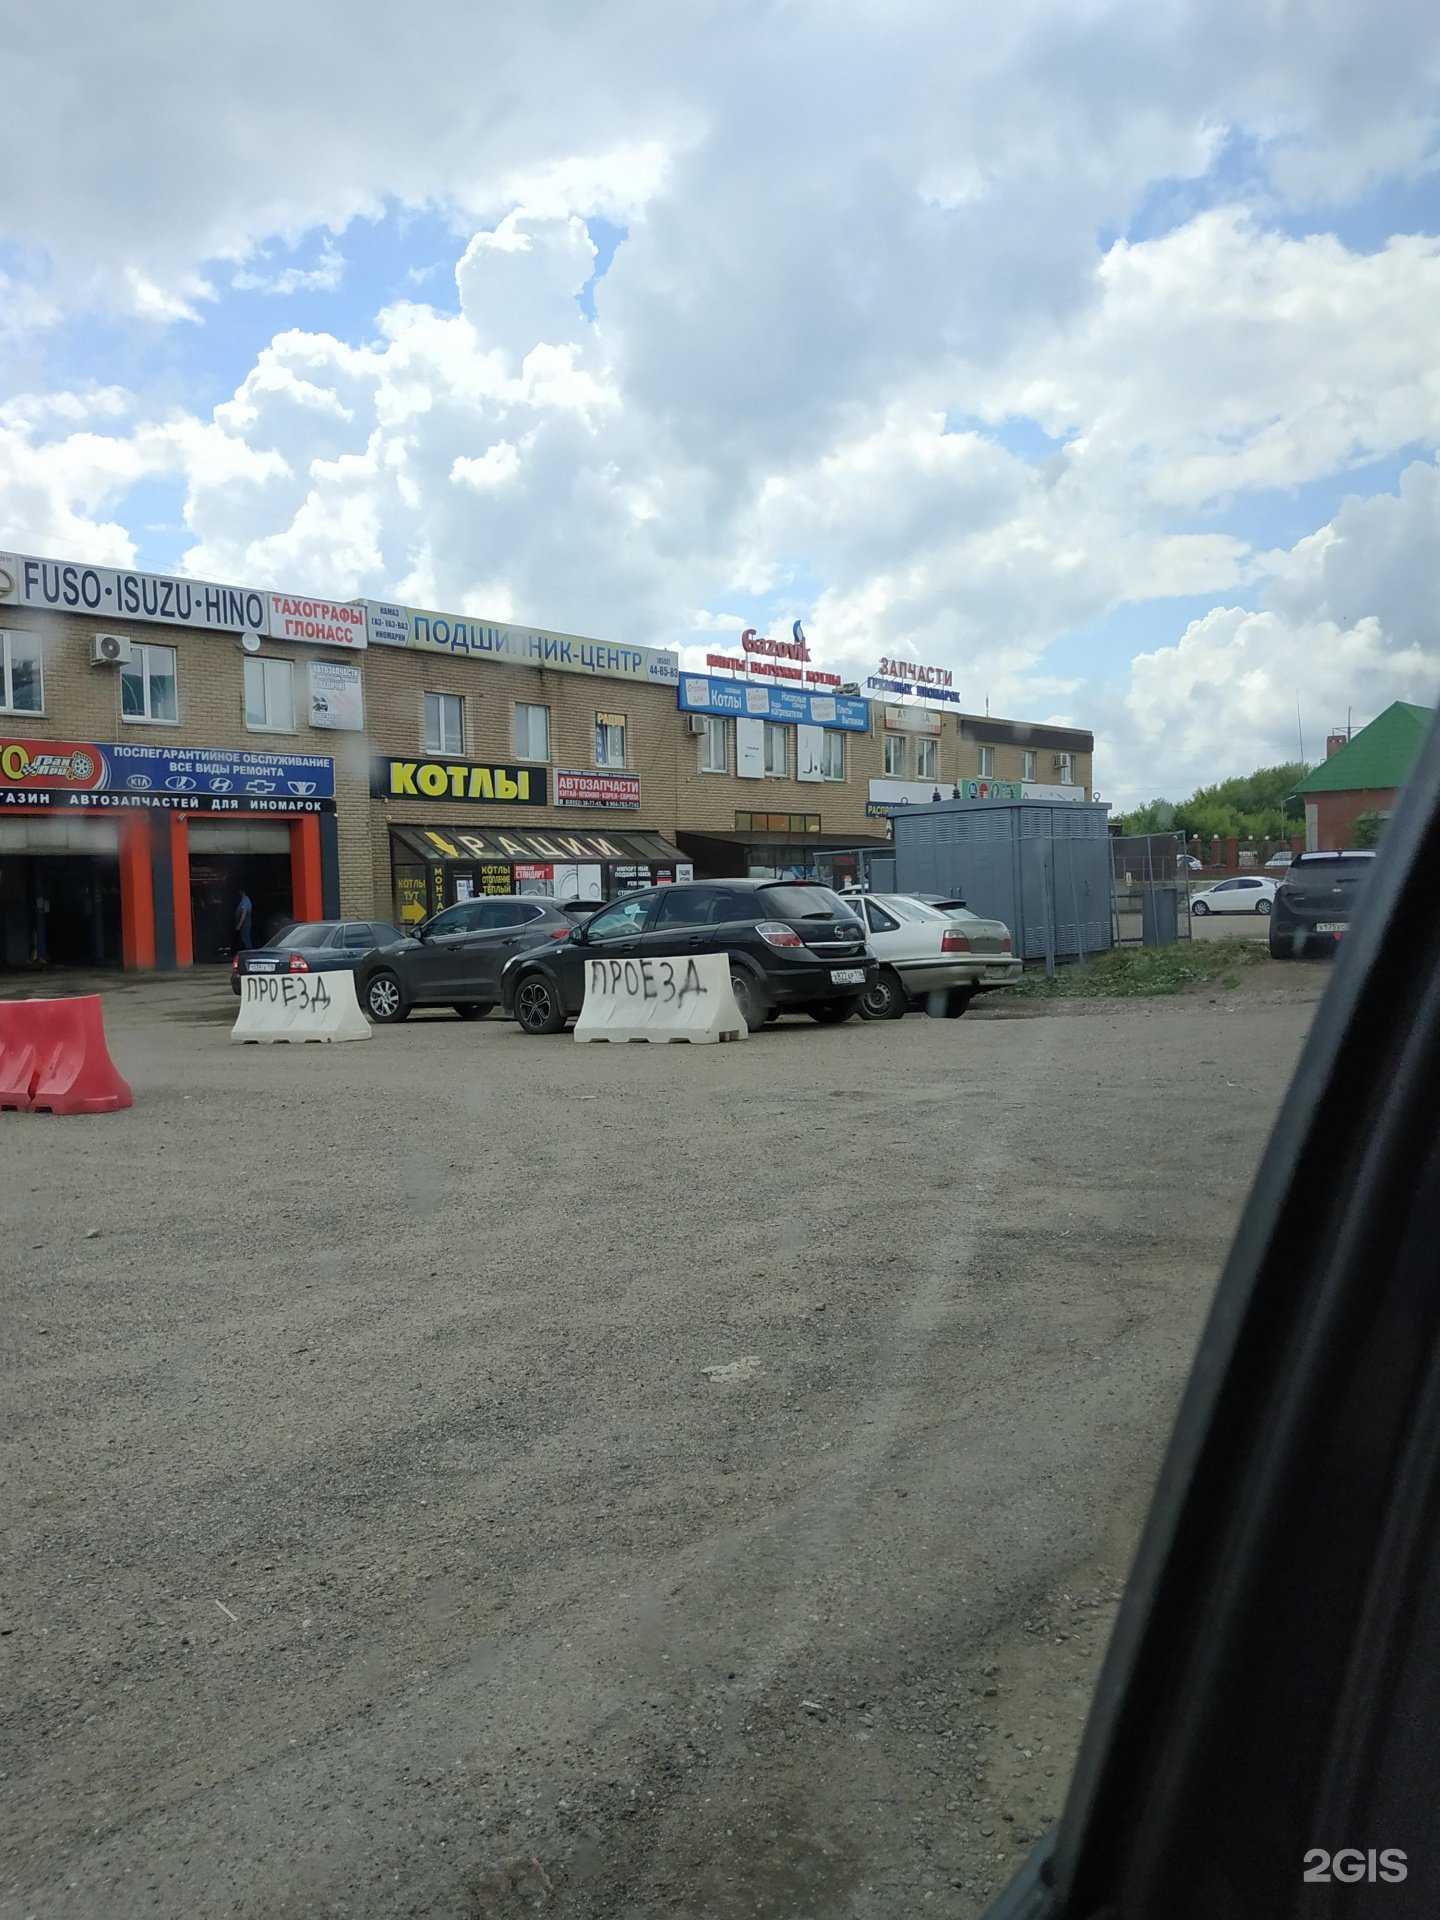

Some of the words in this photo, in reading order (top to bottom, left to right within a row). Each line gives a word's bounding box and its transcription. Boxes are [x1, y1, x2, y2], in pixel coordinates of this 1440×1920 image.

[24, 561, 101, 608] FUSO
[116, 574, 192, 619] ISUZU
[205, 589, 263, 628] HINO
[272, 594, 363, 625] ТАХОГРАФЫ
[285, 620, 353, 643] ГЛОНАСС
[879, 657, 953, 686] ЗАПЧАСТИ
[711, 689, 743, 708] Котлы
[169, 762, 193, 773] ВСЕ
[195, 764, 231, 775] ВИДЫ
[232, 766, 285, 777] РЕМОНТА
[242, 755, 331, 768] ОБСЛУЖИВАНИЕ
[389, 762, 530, 800] КОТЛЫ
[559, 777, 639, 793] АВТОЗАПЧАСТИ
[70, 794, 199, 808] АВТОЗАПЧАСТЕЙ
[211, 799, 239, 810] ДЛЯ
[250, 800, 322, 811] ИНОМАРОК
[457, 835, 624, 858] РАЦИИ
[481, 865, 511, 874] КОТЛЫ
[434, 868, 445, 912] МОНТА
[591, 957, 708, 1008] ПРОЕЗД
[247, 976, 331, 1013] ПРОЕЗД
